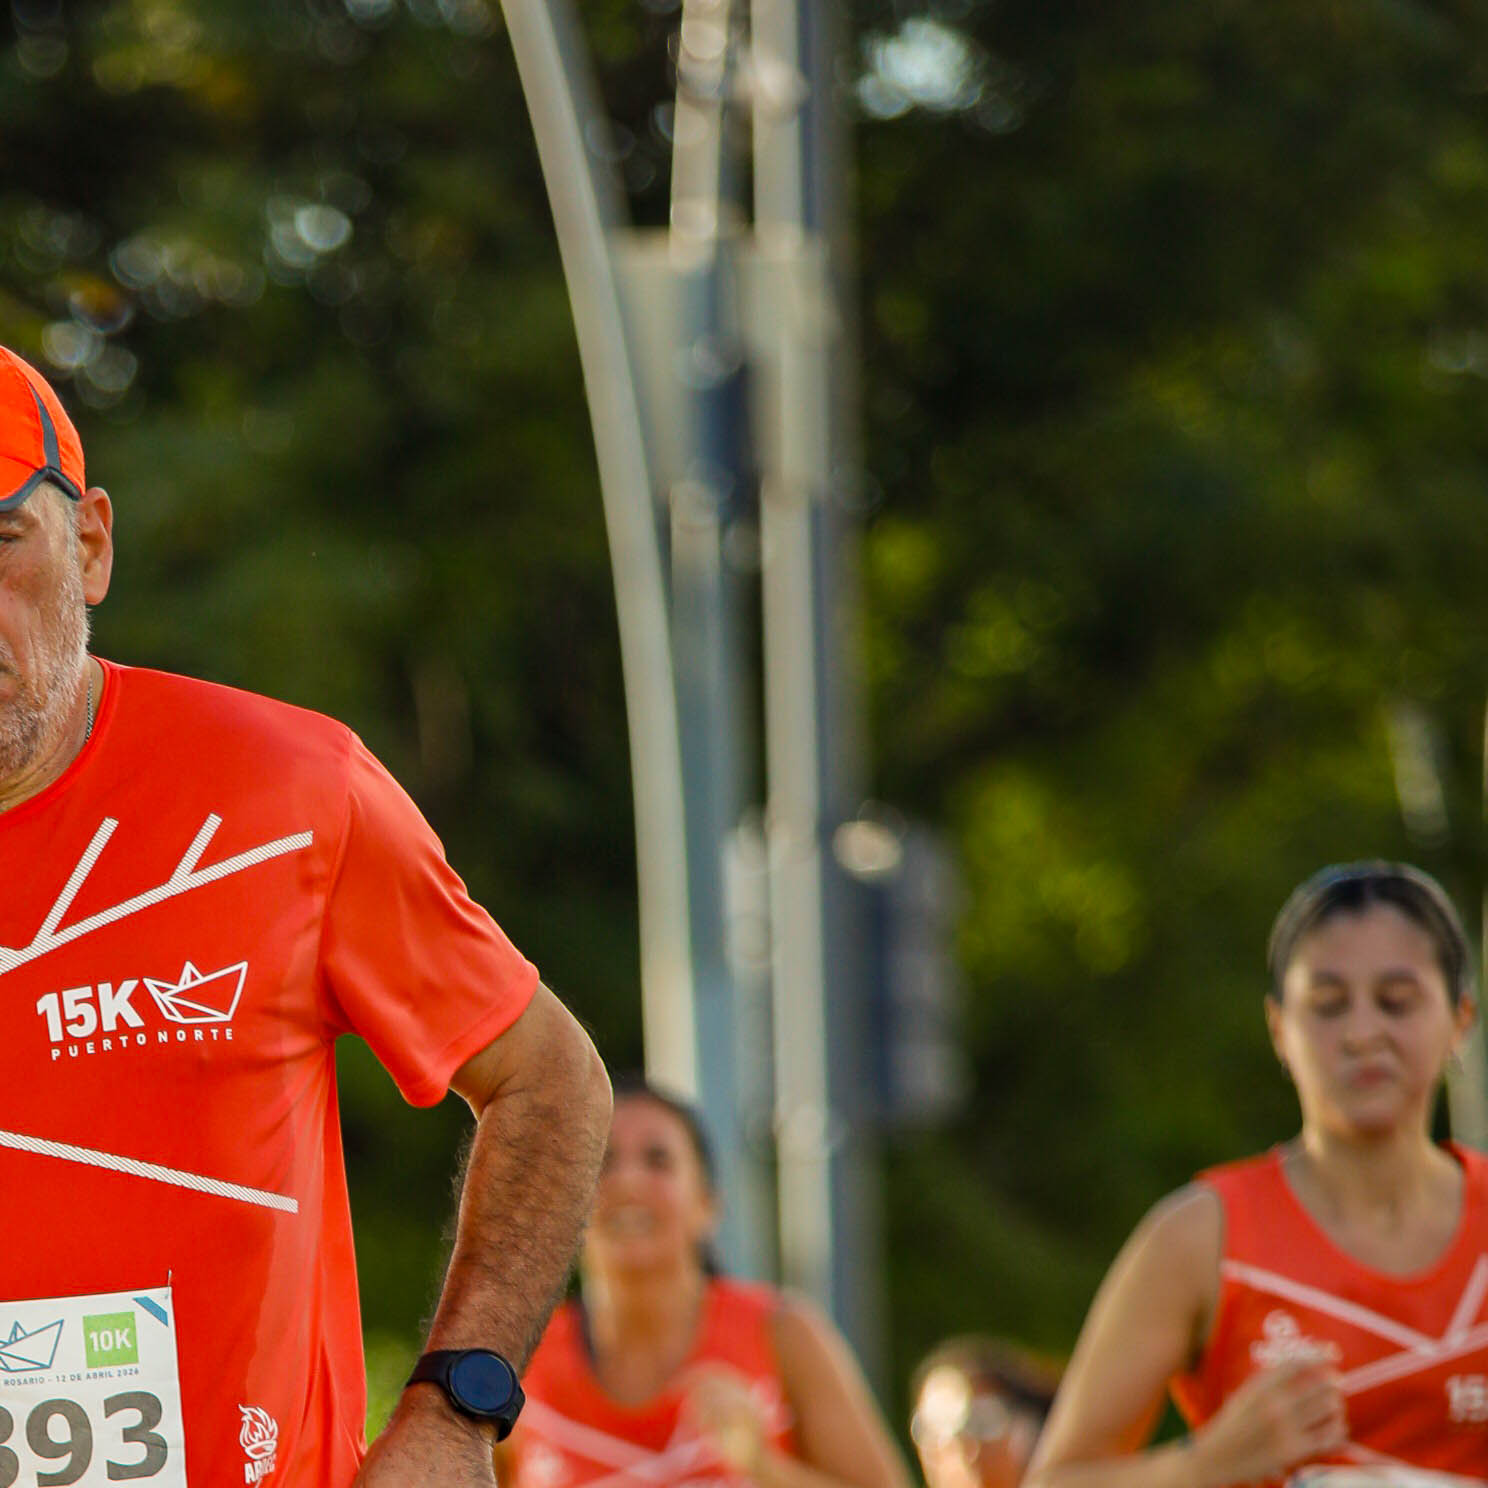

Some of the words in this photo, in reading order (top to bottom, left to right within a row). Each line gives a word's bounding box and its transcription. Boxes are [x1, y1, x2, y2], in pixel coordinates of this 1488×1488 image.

[36, 979, 145, 1042] 15K
[51, 1033, 147, 1061] PUERTO
[158, 1028, 233, 1043] NORTE
[89, 1328, 132, 1353] 10K
[3, 1376, 45, 1387] ROSARIO
[56, 1373, 67, 1383] 12
[70, 1372, 82, 1381] DE
[86, 1369, 115, 1380] ABRIL
